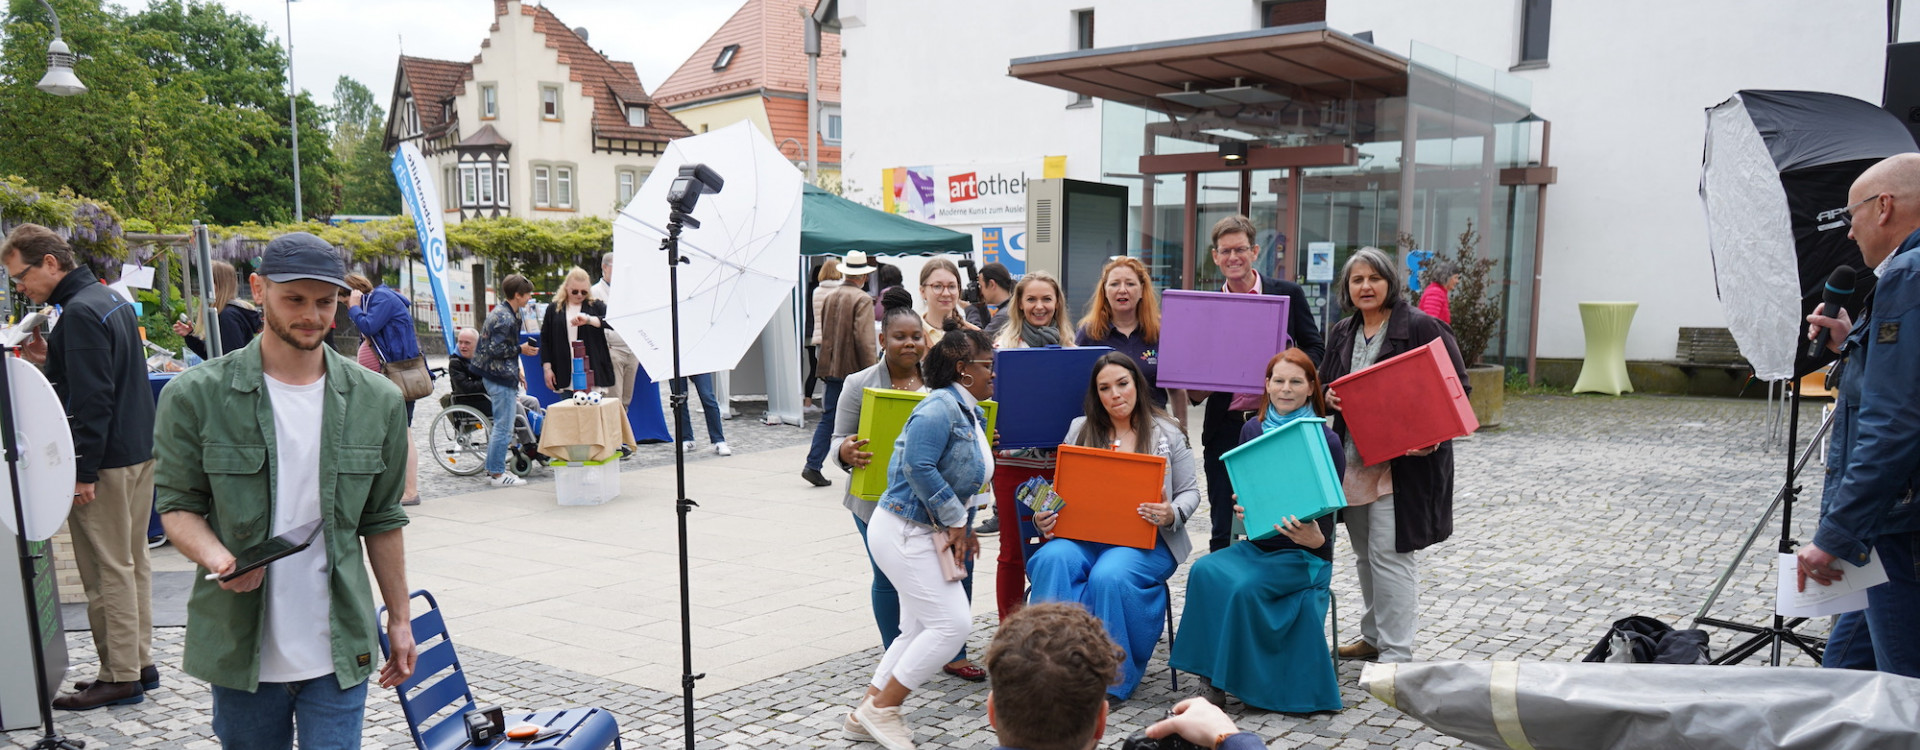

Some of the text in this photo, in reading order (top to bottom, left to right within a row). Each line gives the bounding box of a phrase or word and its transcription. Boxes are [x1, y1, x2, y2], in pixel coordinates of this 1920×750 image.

[938, 207, 967, 216] Moderne
[969, 206, 987, 215] Kunst
[989, 206, 1003, 214] zum
